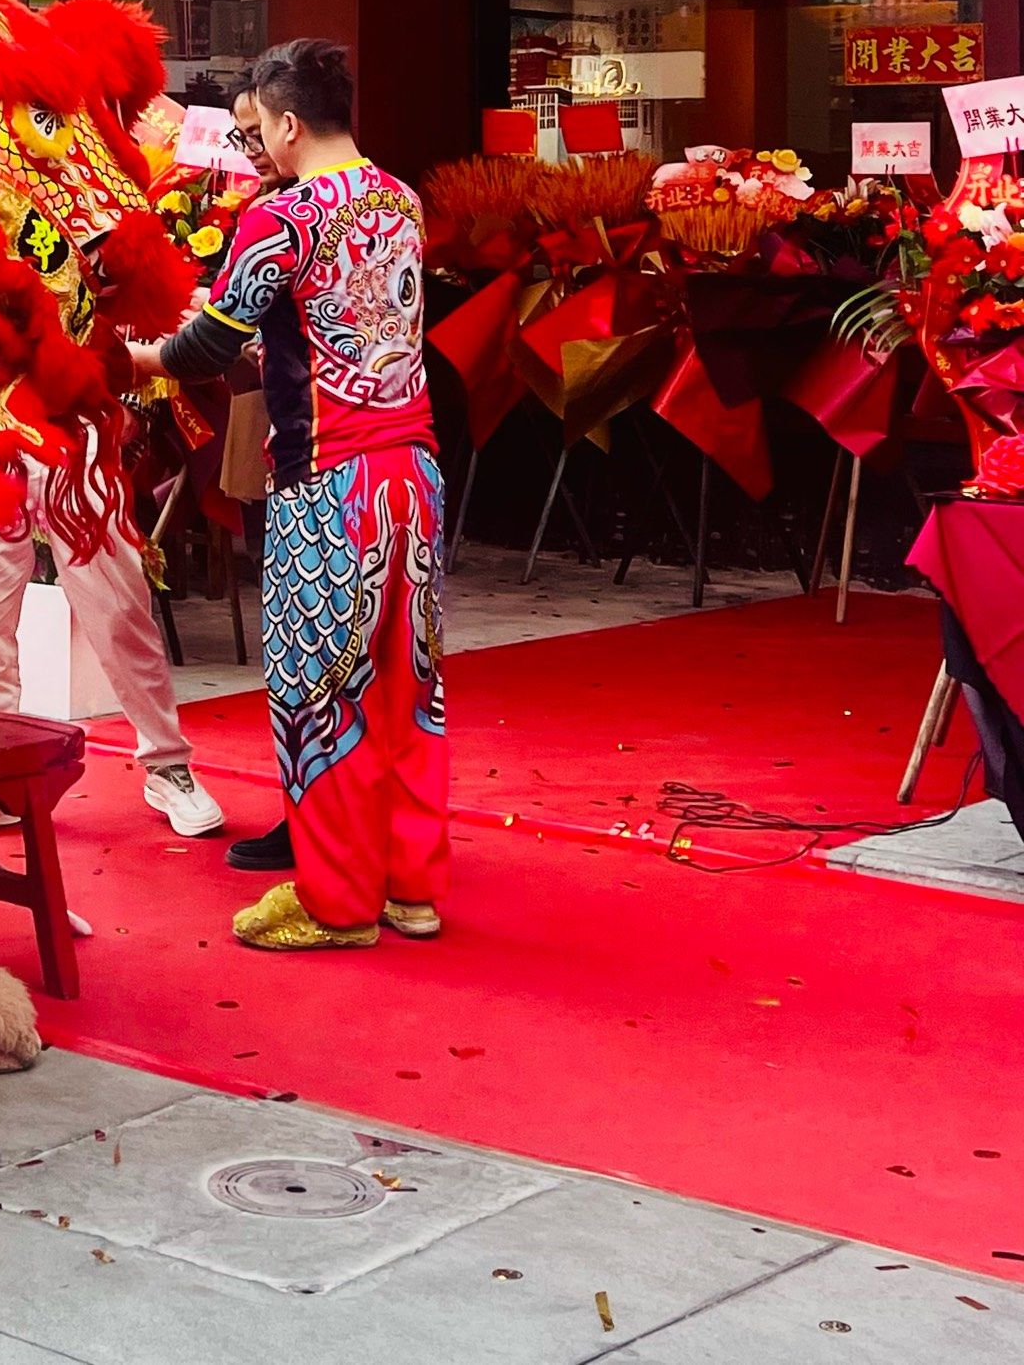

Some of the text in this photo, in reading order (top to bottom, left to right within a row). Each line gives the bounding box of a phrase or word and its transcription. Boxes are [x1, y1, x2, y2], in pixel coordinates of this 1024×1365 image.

[852, 36, 976, 73] 開業大吉
[963, 102, 1024, 133] 開業大
[189, 126, 232, 149] 開業
[860, 139, 922, 159] 開業大吉
